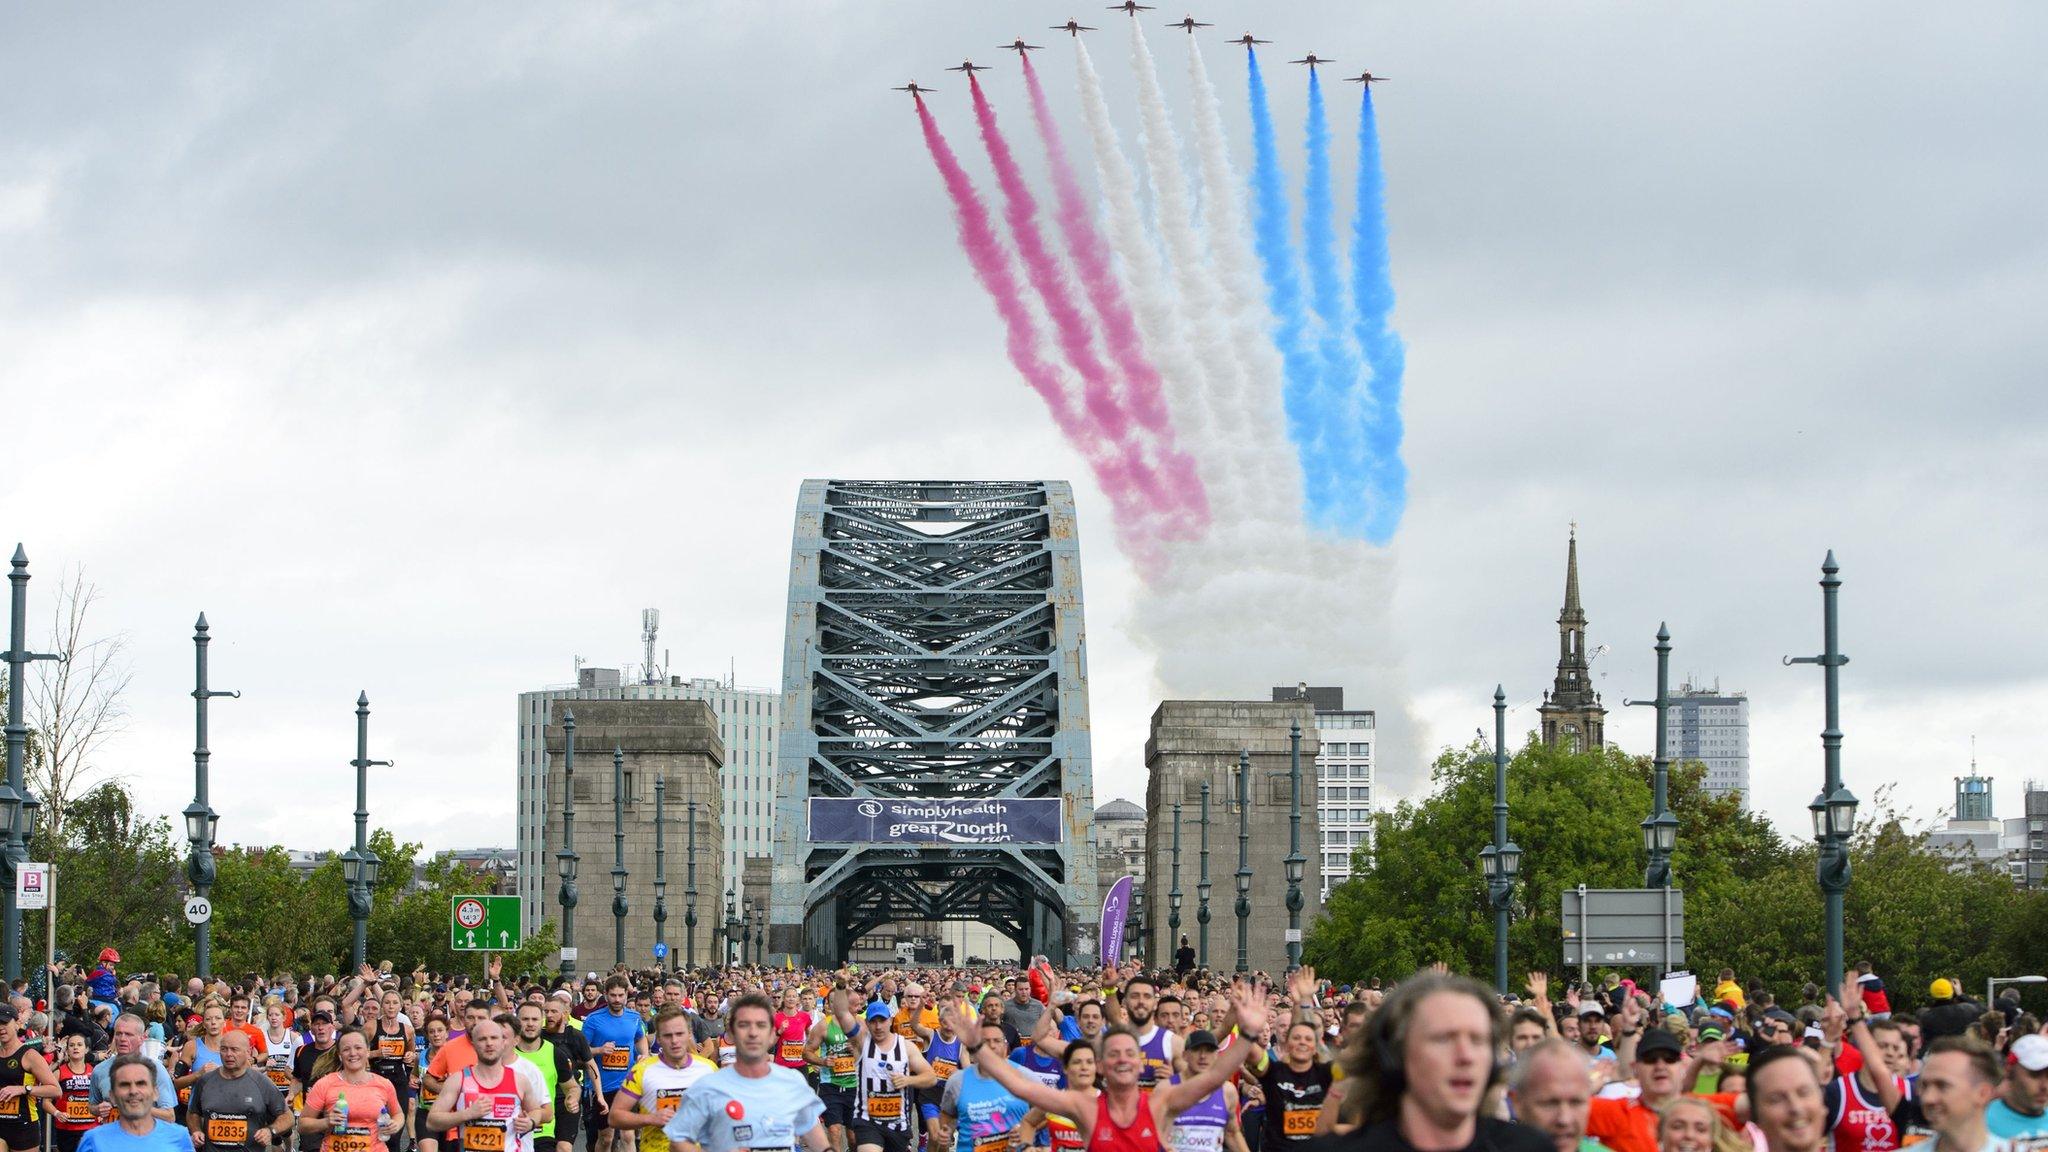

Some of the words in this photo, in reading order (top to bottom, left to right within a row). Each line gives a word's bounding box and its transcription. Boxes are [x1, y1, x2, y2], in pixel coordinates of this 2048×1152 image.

[891, 804, 1007, 818] Simplyhealth
[889, 823, 939, 837] great
[955, 822, 1008, 835] north
[979, 835, 1011, 843] run
[28, 874, 38, 885] B
[189, 904, 208, 916] 40
[604, 1055, 627, 1064] 7899
[68, 1106, 90, 1116] 1023
[869, 1101, 900, 1113] 14325
[210, 1125, 245, 1138] 12835
[466, 1133, 502, 1146] 14221
[332, 1140, 367, 1152] 8092
